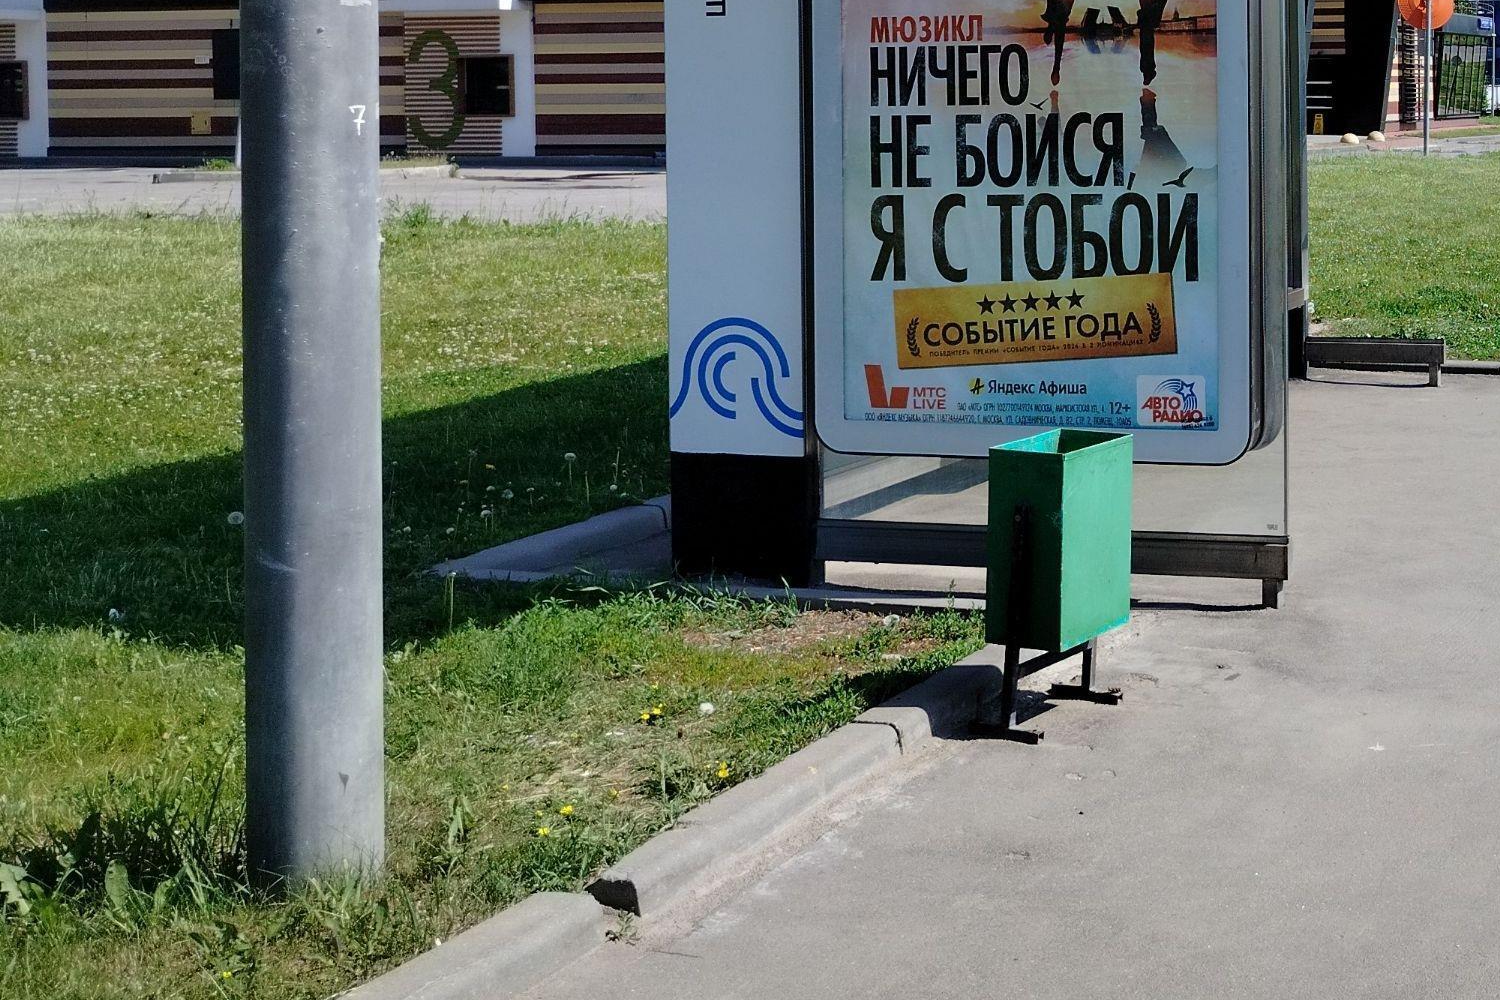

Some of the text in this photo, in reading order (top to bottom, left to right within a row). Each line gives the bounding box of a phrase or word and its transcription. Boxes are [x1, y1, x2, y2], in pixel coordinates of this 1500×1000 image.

[869, 15, 983, 43] МЮЗИКЛ
[406, 28, 466, 149] 3
[869, 44, 1030, 107] НИЧЕГО
[348, 104, 366, 136] 7
[869, 114, 931, 189] НЕ
[869, 194, 907, 282] Я
[932, 193, 968, 280] С
[923, 311, 1144, 347] СОБЫТИЕ ГОДА
[988, 379, 1088, 397] Яндекс Афиша
[1141, 396, 1181, 410] АВТО
[913, 398, 946, 410] LIVE
[1109, 401, 1131, 415] 12+
[1152, 409, 1203, 423] РАДИО
